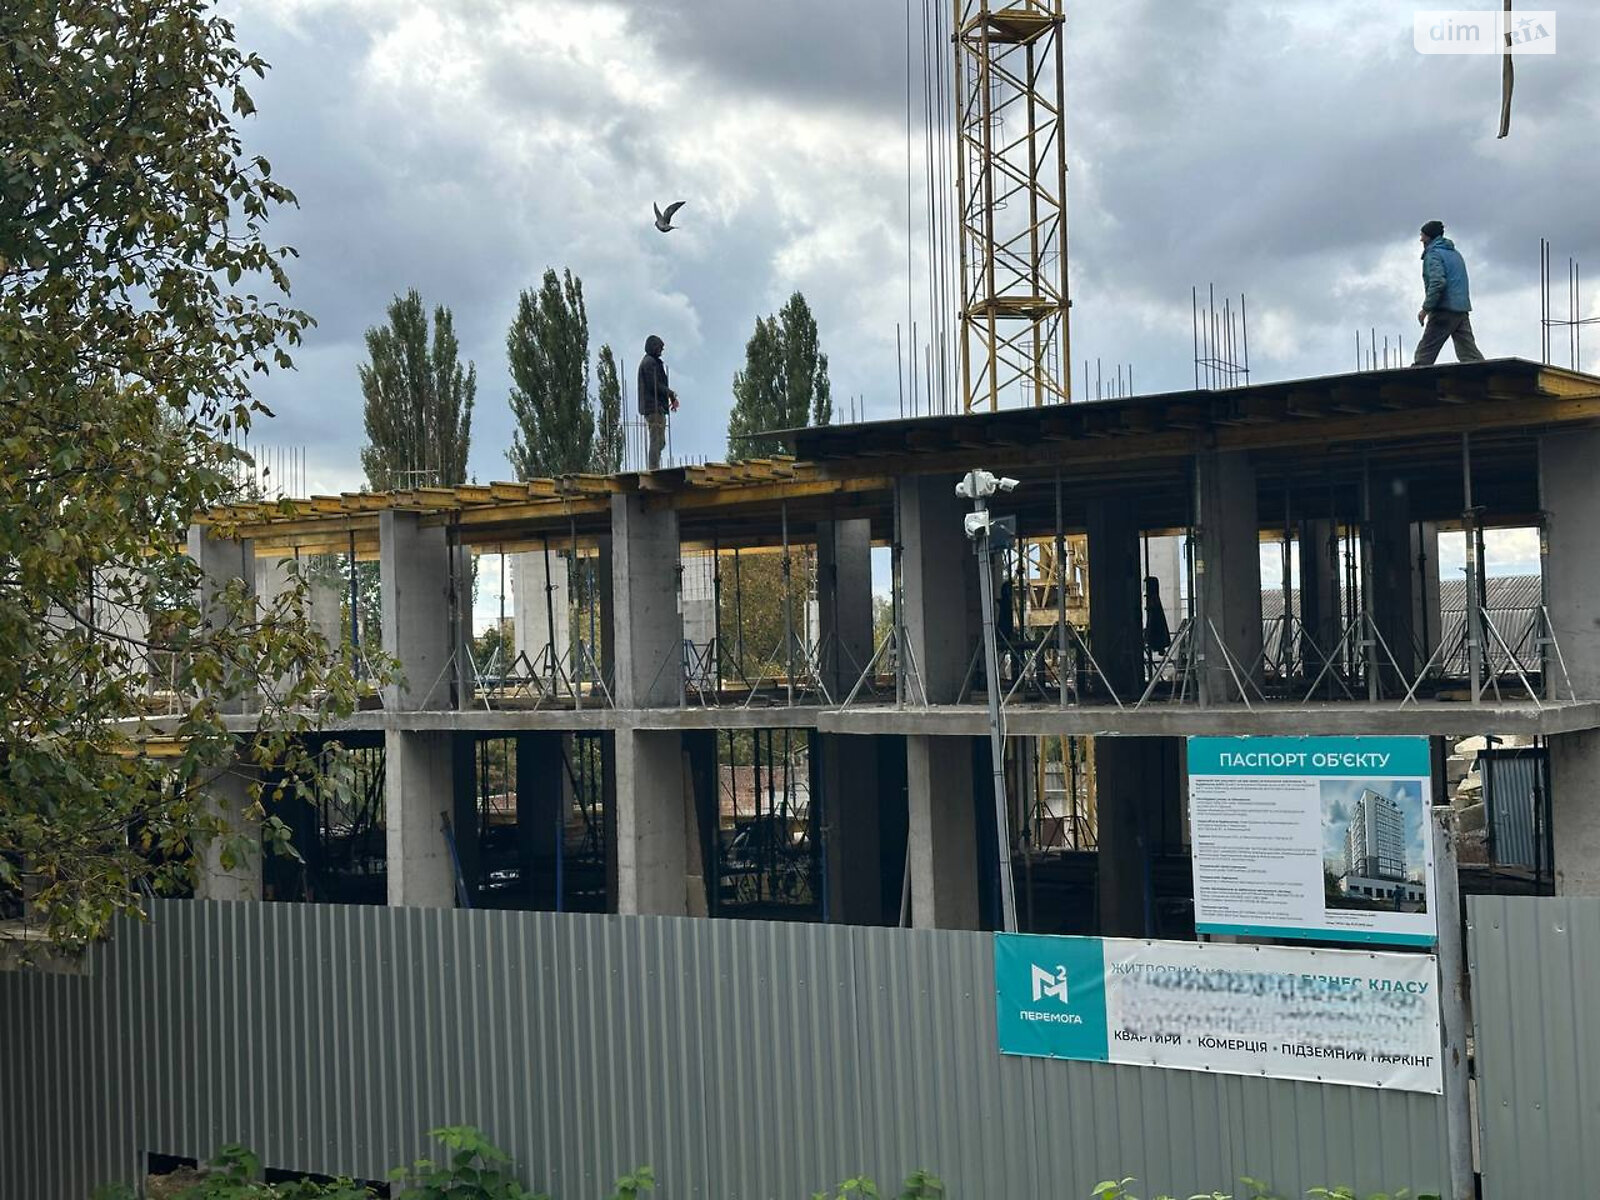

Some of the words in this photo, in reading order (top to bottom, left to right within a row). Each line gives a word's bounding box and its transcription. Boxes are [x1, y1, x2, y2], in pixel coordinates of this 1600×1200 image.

[1219, 753, 1307, 767] ПАСПОРТ
[1312, 752, 1391, 767] ОБ'ЄКТУ
[1369, 978, 1429, 994] КЛАСУ
[1020, 1011, 1083, 1025] ПЕРЕМОГА
[1198, 1036, 1268, 1052] КОМЕРЦІЯ
